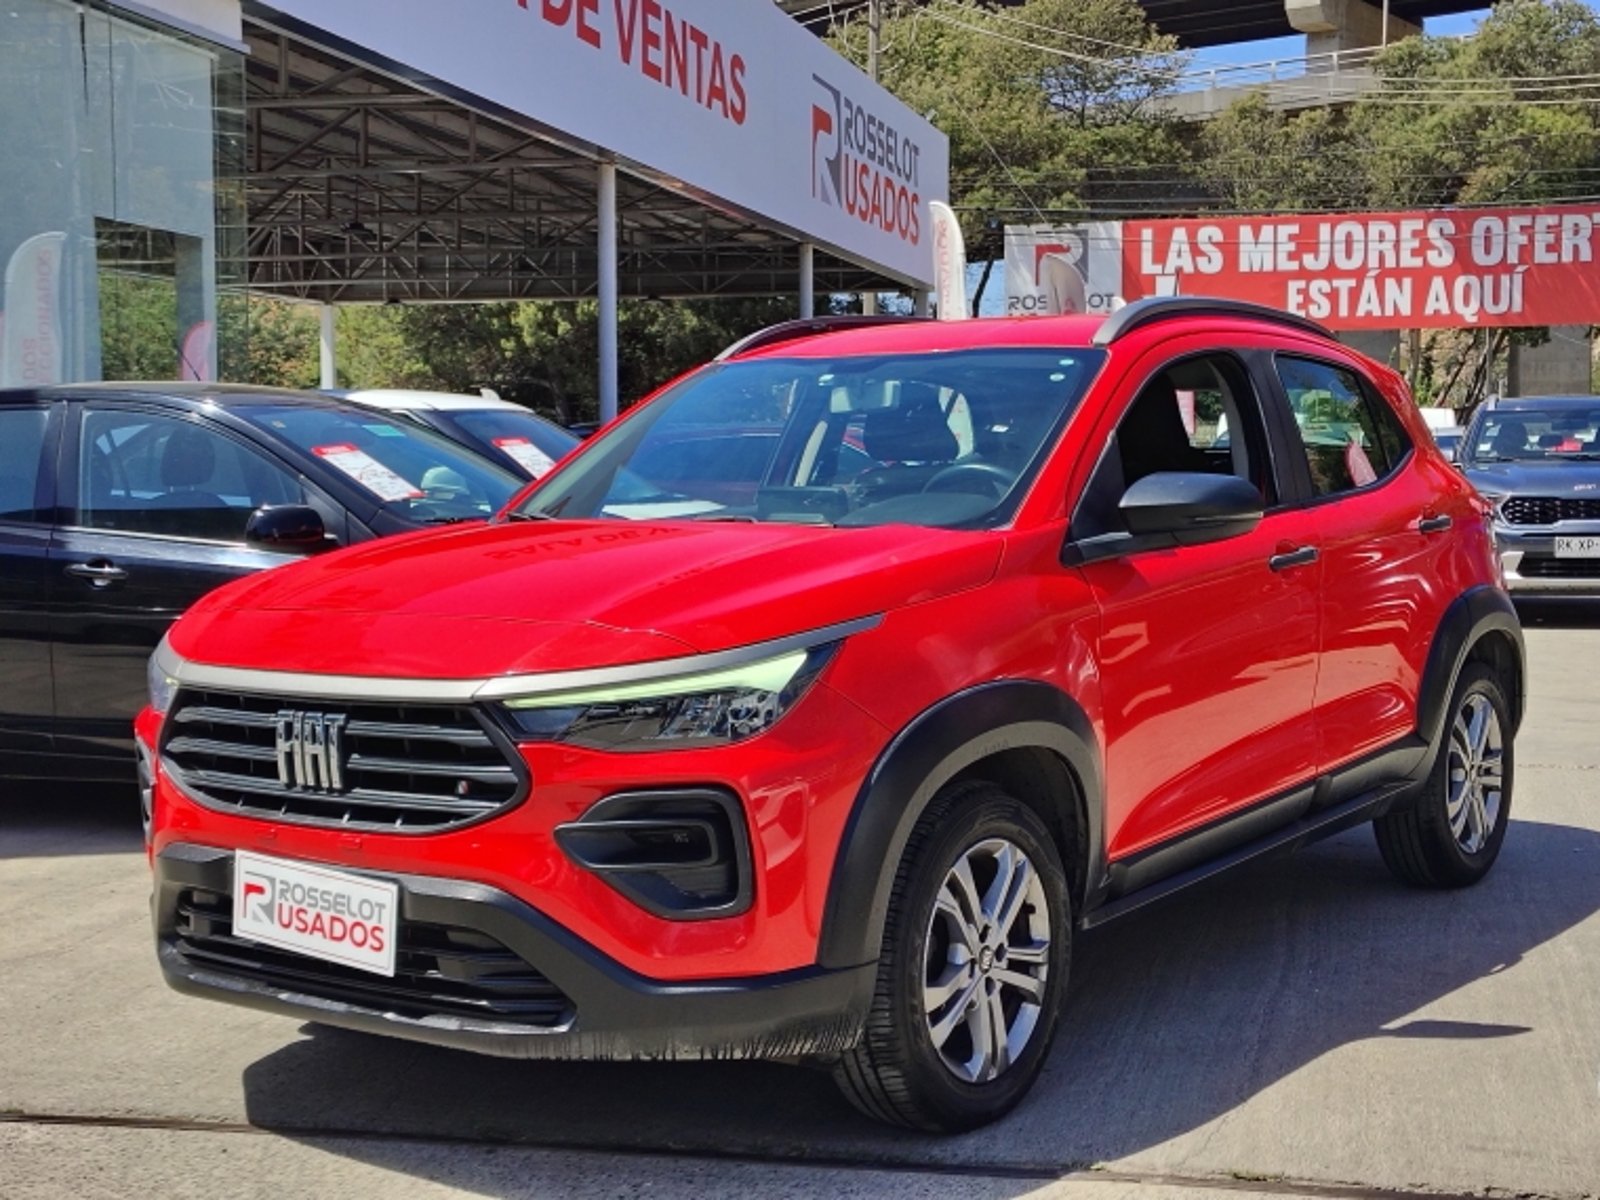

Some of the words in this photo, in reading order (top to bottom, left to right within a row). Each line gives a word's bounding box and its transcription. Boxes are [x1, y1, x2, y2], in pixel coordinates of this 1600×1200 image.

[541, 0, 602, 49] E
[613, 0, 747, 126] VENTAS
[843, 96, 920, 188] ROSSELOT
[843, 157, 920, 247] USADOS
[1140, 226, 1225, 275] LAS
[1238, 217, 1456, 273] MEJORES
[1471, 213, 1600, 267] OFER
[1287, 269, 1412, 319] ESTÁN
[1424, 264, 1530, 323] AQUÍ
[275, 710, 346, 788] FIAT
[277, 902, 385, 953] USADOS
[278, 880, 387, 924] ROSSELOT
